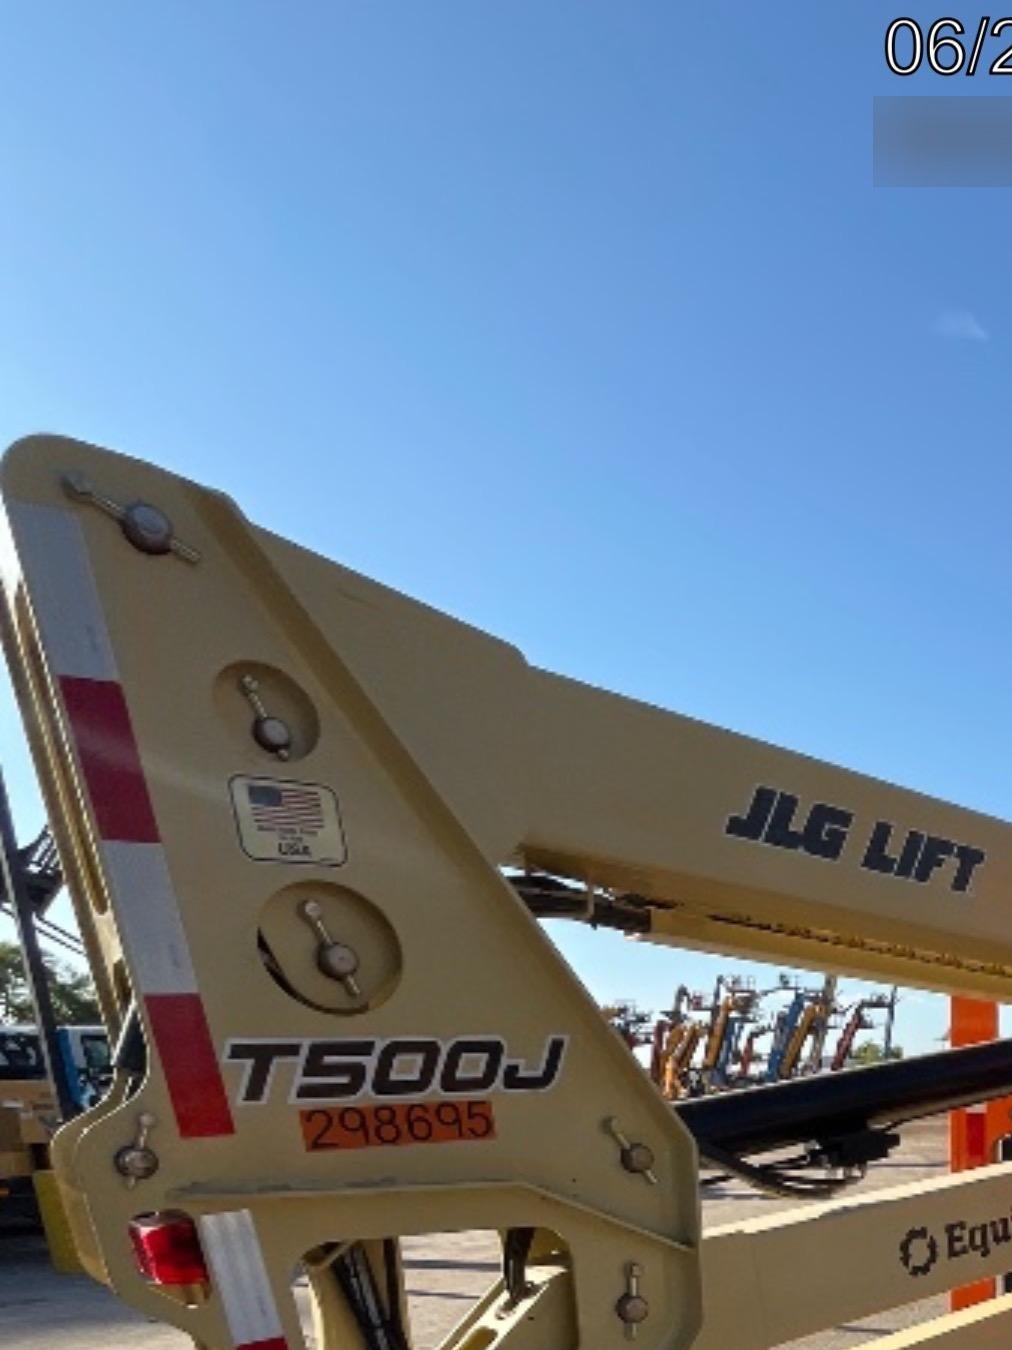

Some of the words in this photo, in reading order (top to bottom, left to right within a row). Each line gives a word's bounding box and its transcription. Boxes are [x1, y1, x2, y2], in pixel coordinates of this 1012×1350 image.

[725, 785, 854, 861] JLG
[860, 821, 985, 891] LIFT
[226, 1036, 567, 1103] T500J
[304, 1101, 494, 1149] 298695
